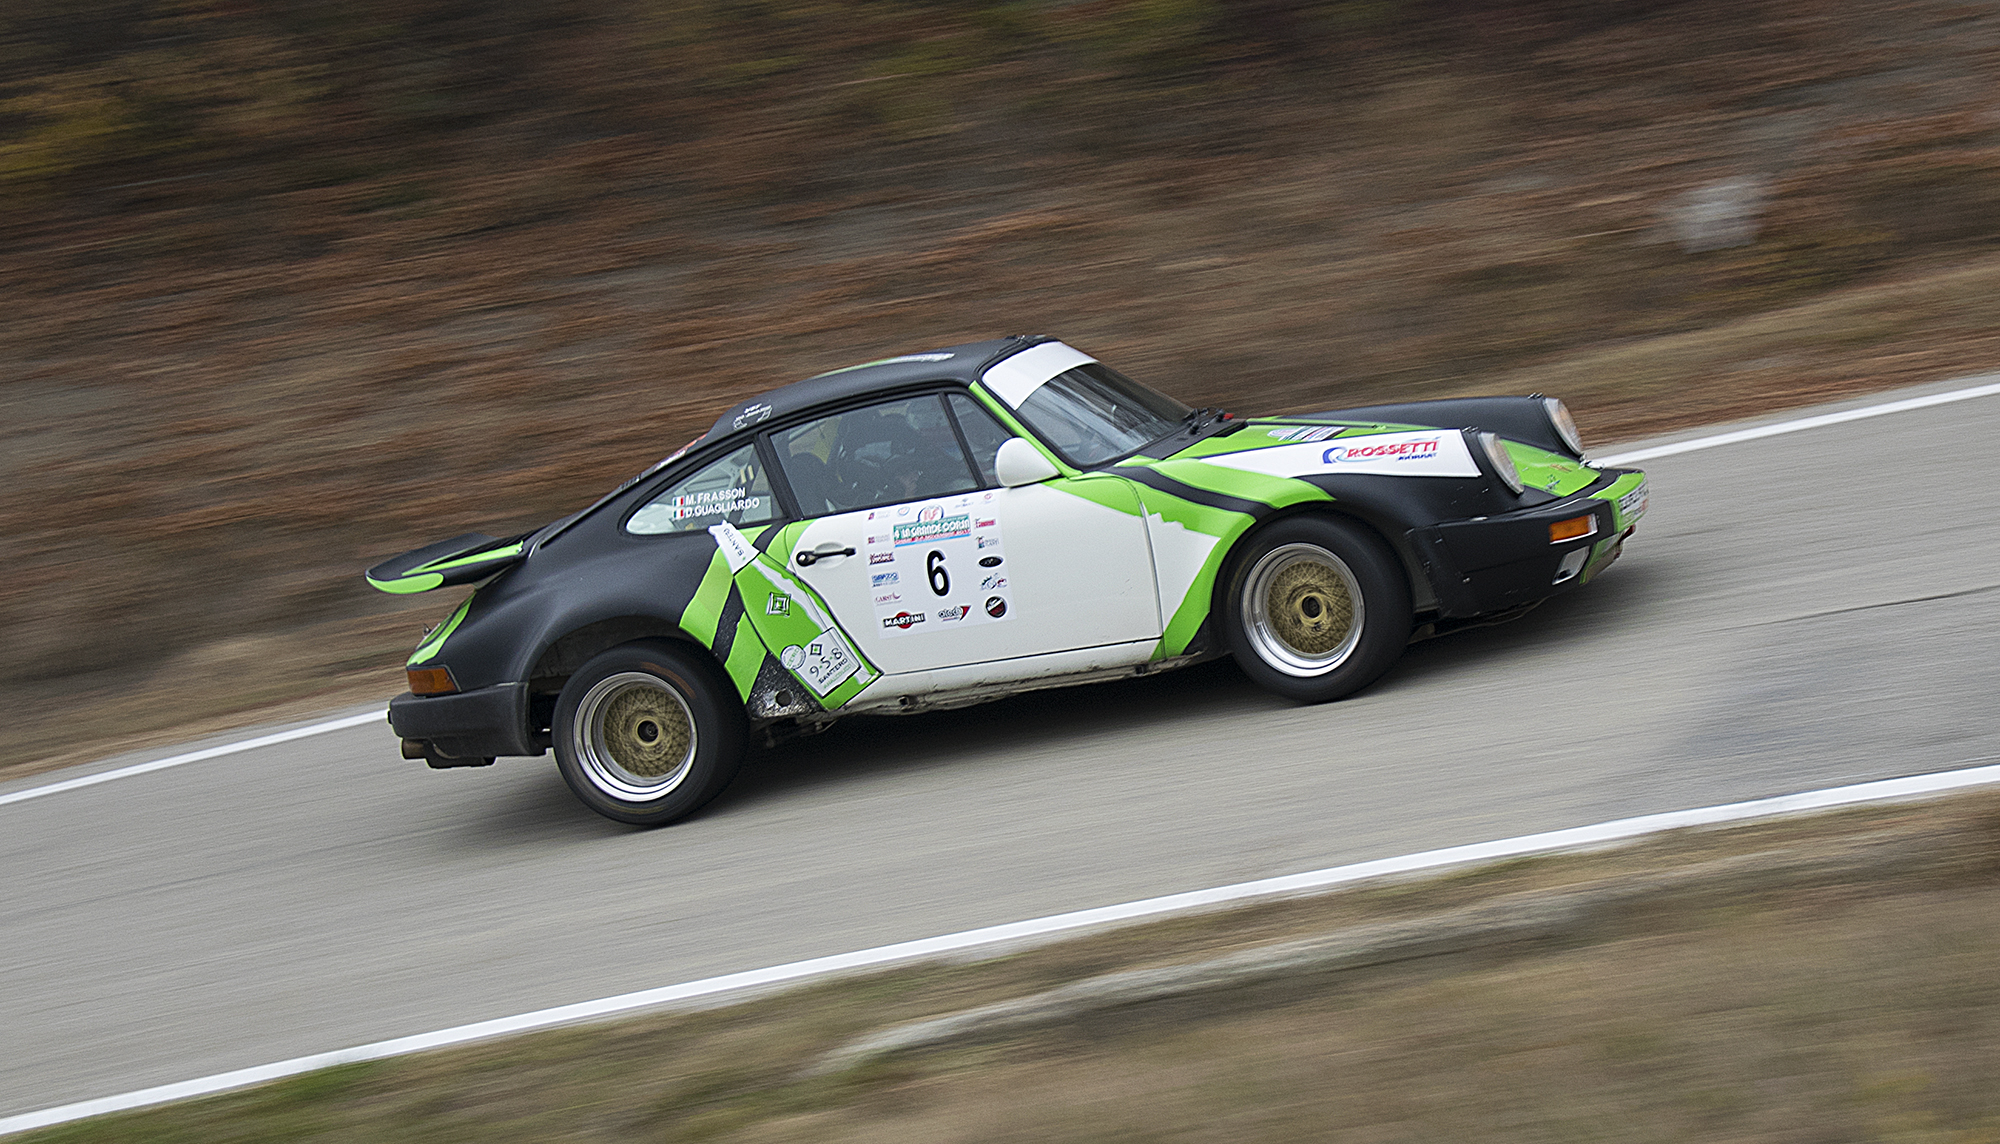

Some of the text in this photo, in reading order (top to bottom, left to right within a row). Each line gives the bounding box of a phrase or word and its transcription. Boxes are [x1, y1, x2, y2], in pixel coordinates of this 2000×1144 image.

[1346, 440, 1438, 458] ROSSETTI
[926, 550, 950, 597] 6
[885, 613, 924, 626] MARTINI
[819, 658, 848, 684] SANTERO
